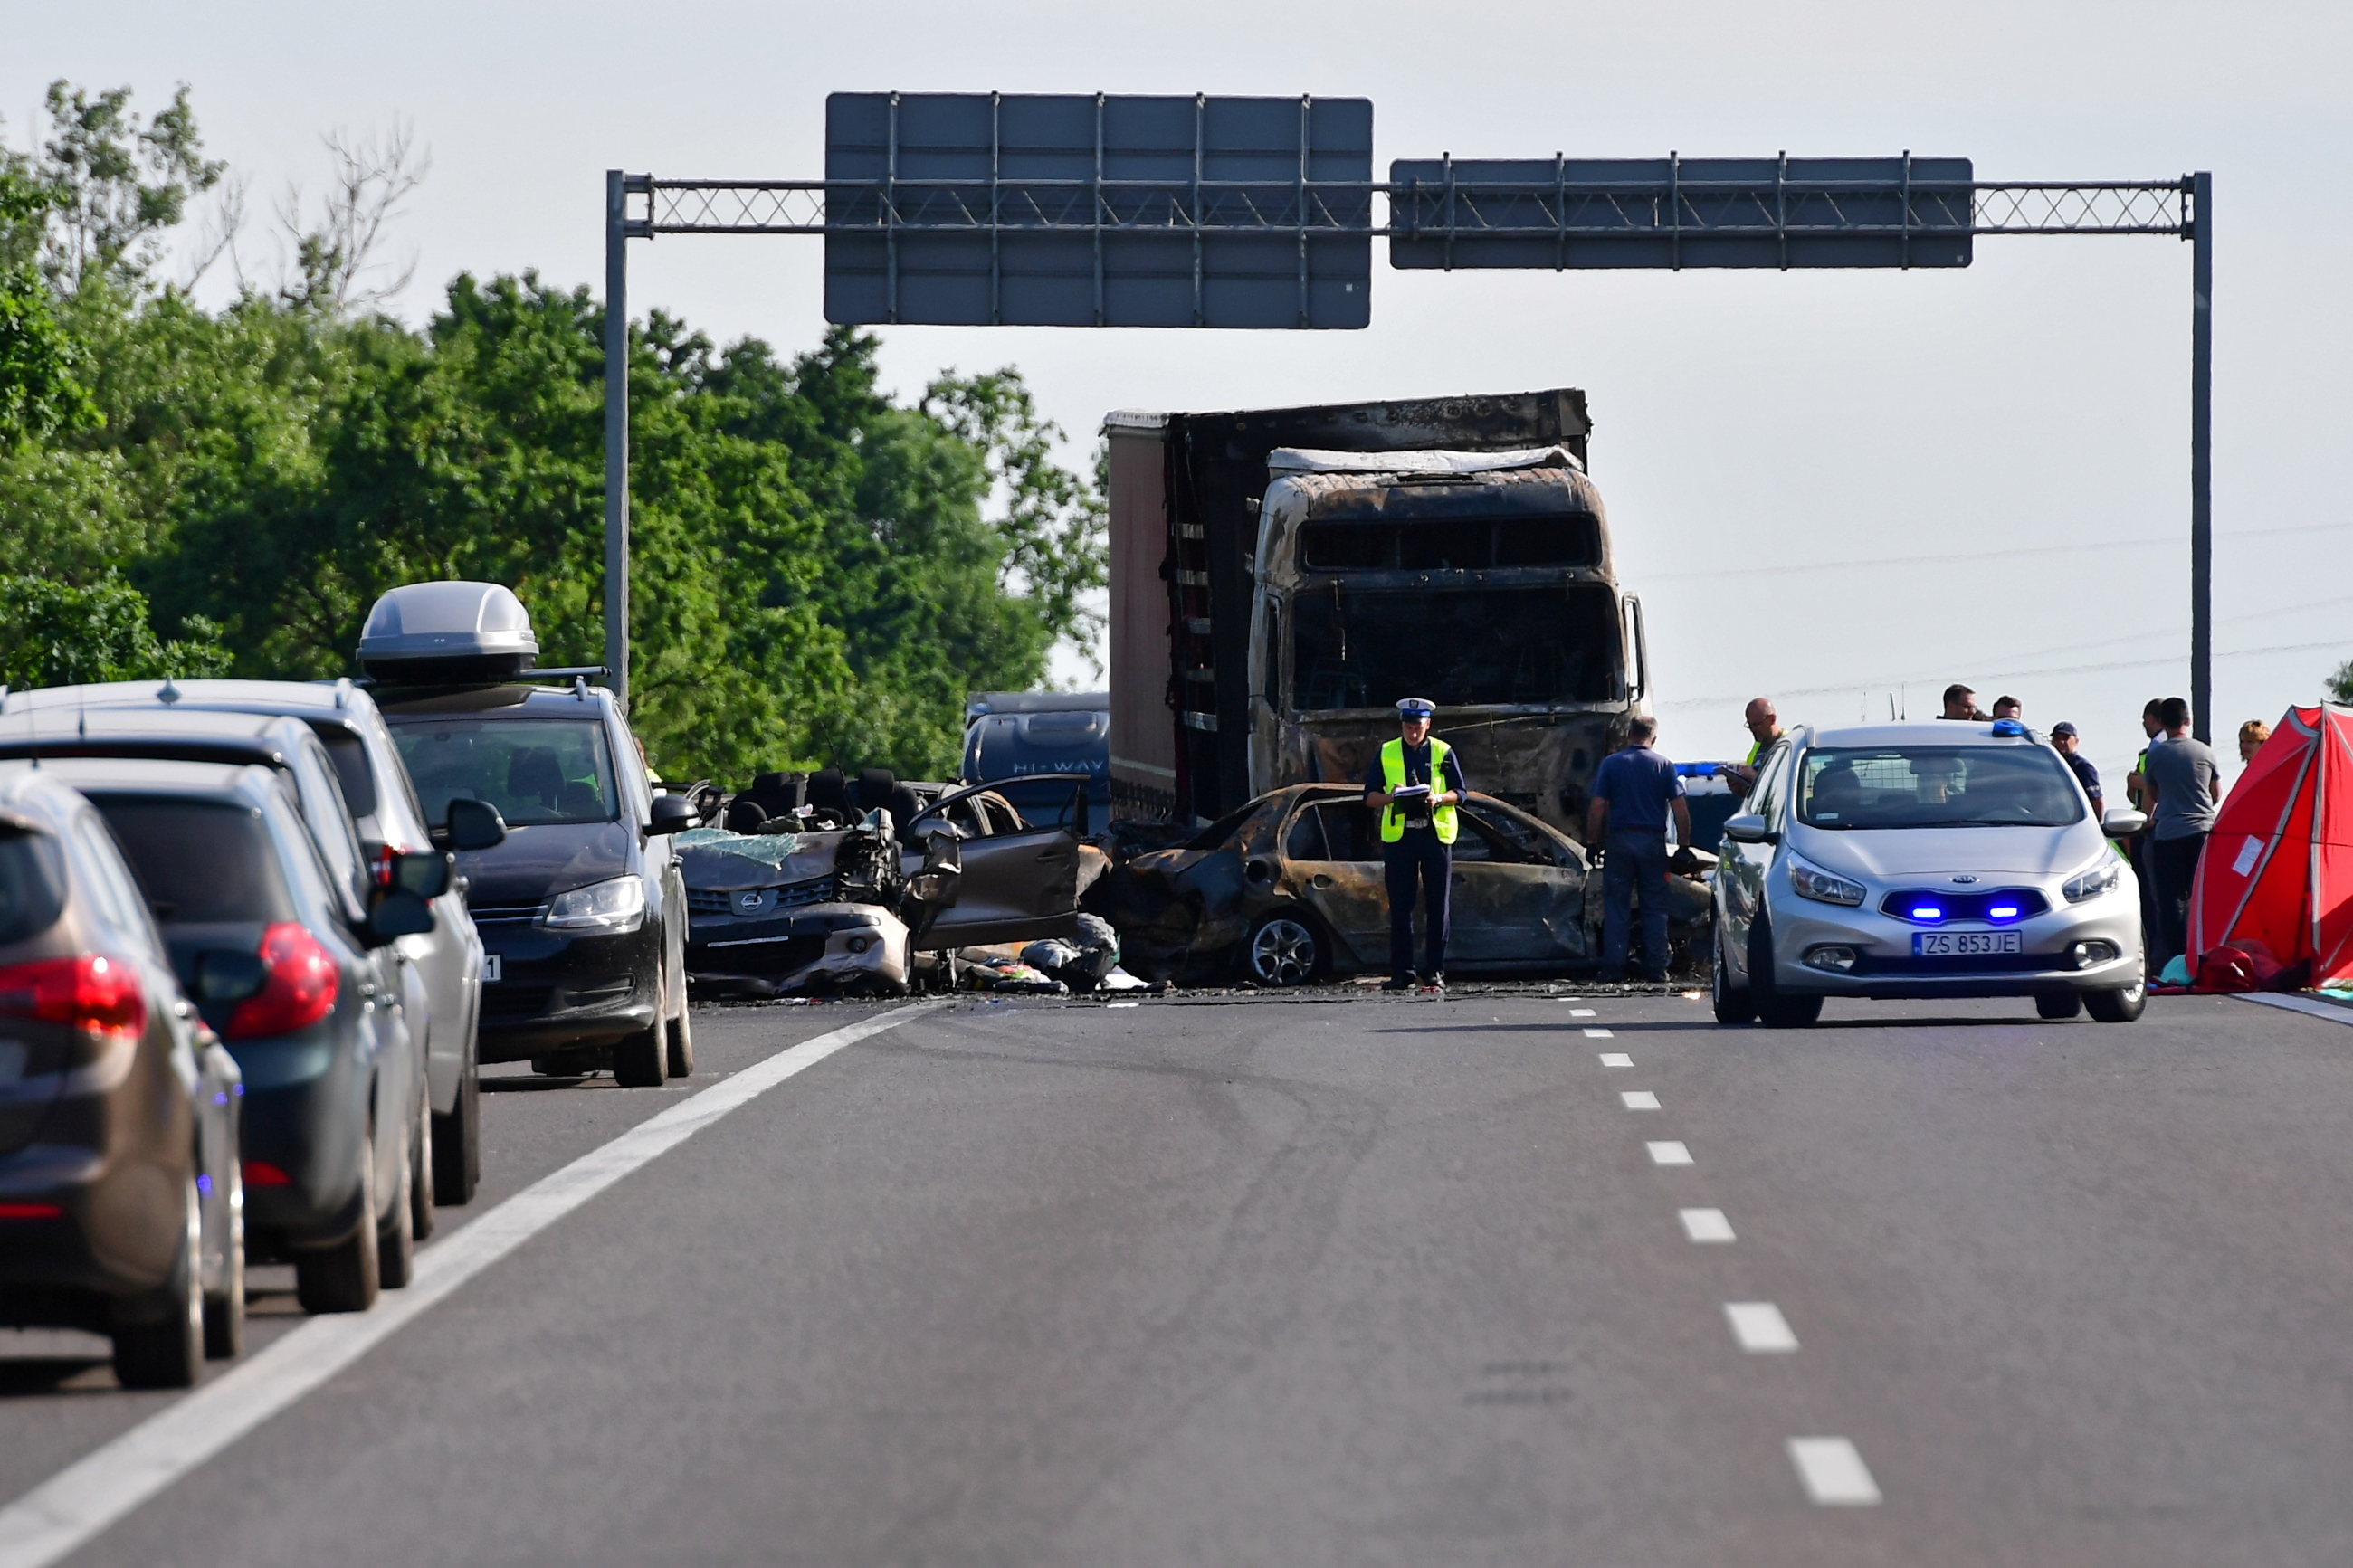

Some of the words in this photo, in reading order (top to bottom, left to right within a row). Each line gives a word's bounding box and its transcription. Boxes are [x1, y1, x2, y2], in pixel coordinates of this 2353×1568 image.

[1014, 760, 1104, 773] HI-WAY
[1926, 936, 1950, 954] ZS
[1958, 934, 2015, 953] 853JE
